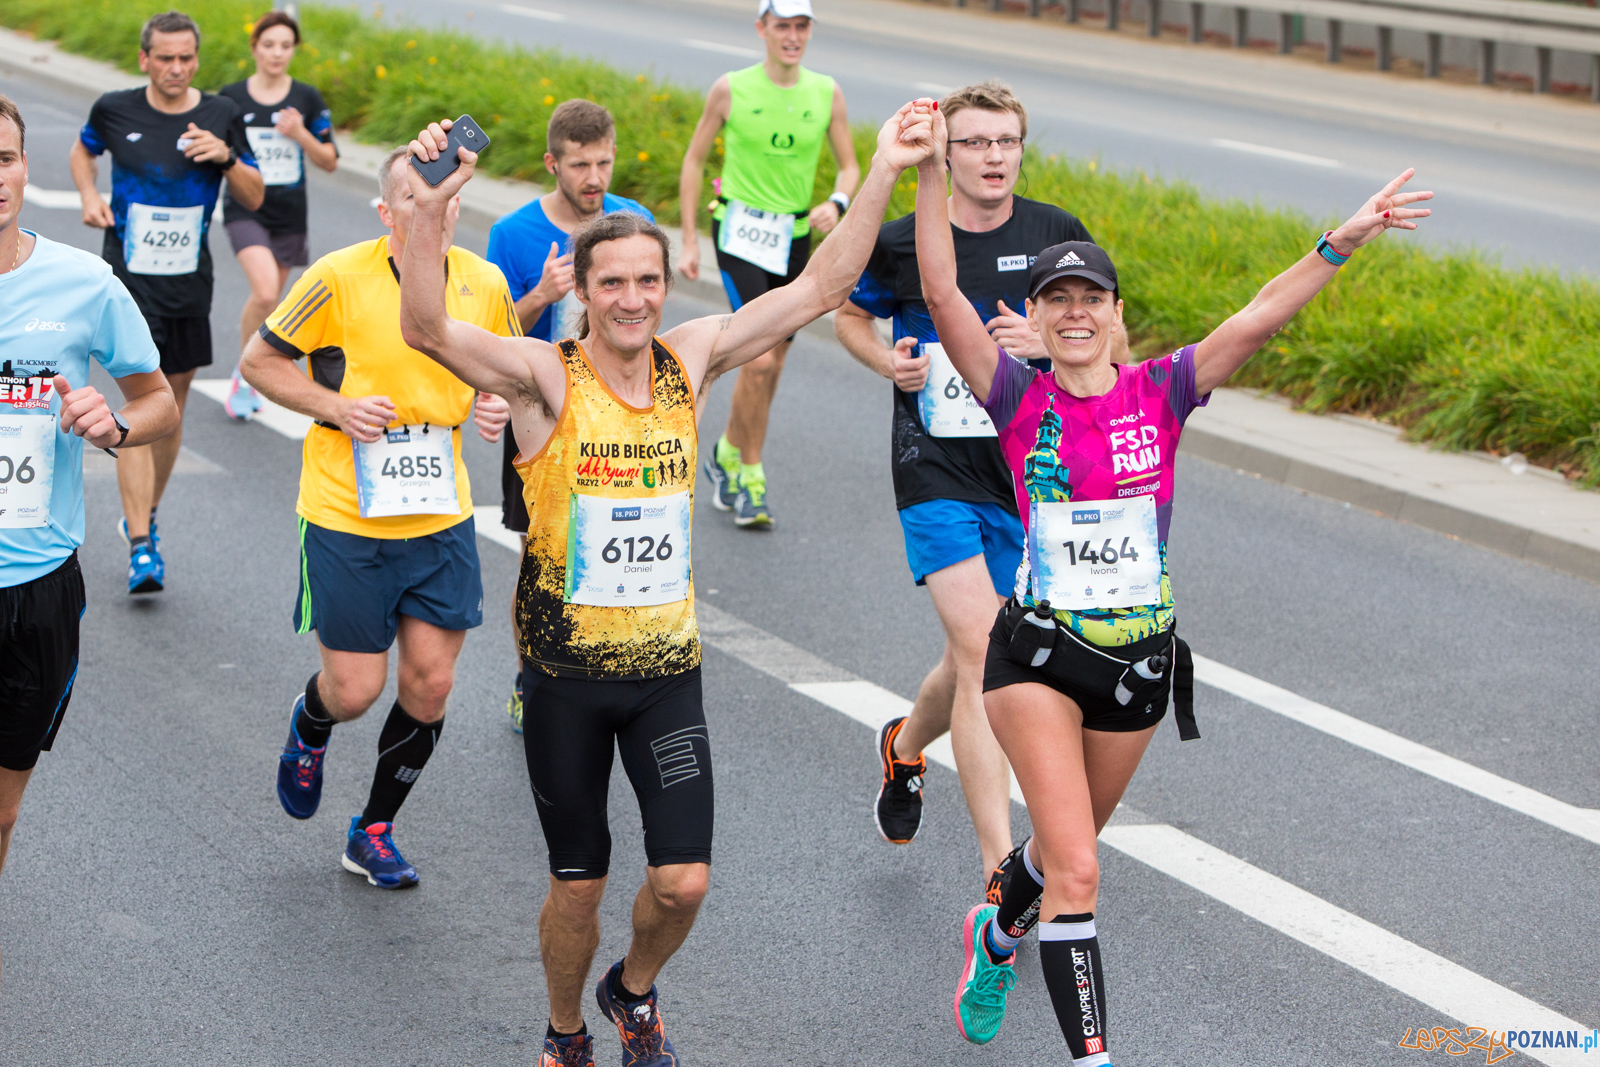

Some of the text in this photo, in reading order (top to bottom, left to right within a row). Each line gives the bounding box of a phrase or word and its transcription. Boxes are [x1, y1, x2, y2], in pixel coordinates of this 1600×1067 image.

[143, 230, 190, 247] 4296
[737, 224, 780, 248] 6073
[1010, 258, 1024, 266] PKO
[1056, 260, 1085, 269] adidas
[17, 359, 58, 367] BLACKMORES
[0, 376, 25, 384] ATHON
[0, 376, 56, 402] ER 17
[944, 377, 972, 400] 69
[1110, 425, 1158, 451] FSD
[580, 442, 620, 458] KLUB
[1112, 445, 1160, 475] RUN
[0, 455, 35, 484] 06
[381, 456, 442, 479] 4855
[577, 455, 641, 485] Aktywni
[577, 478, 634, 488] KRZYŻ WLKP.
[1084, 513, 1099, 521] PKO
[601, 533, 673, 564] 6126
[1062, 536, 1139, 566] 1464
[623, 564, 653, 573] Daniel
[1090, 567, 1118, 575] Iwona
